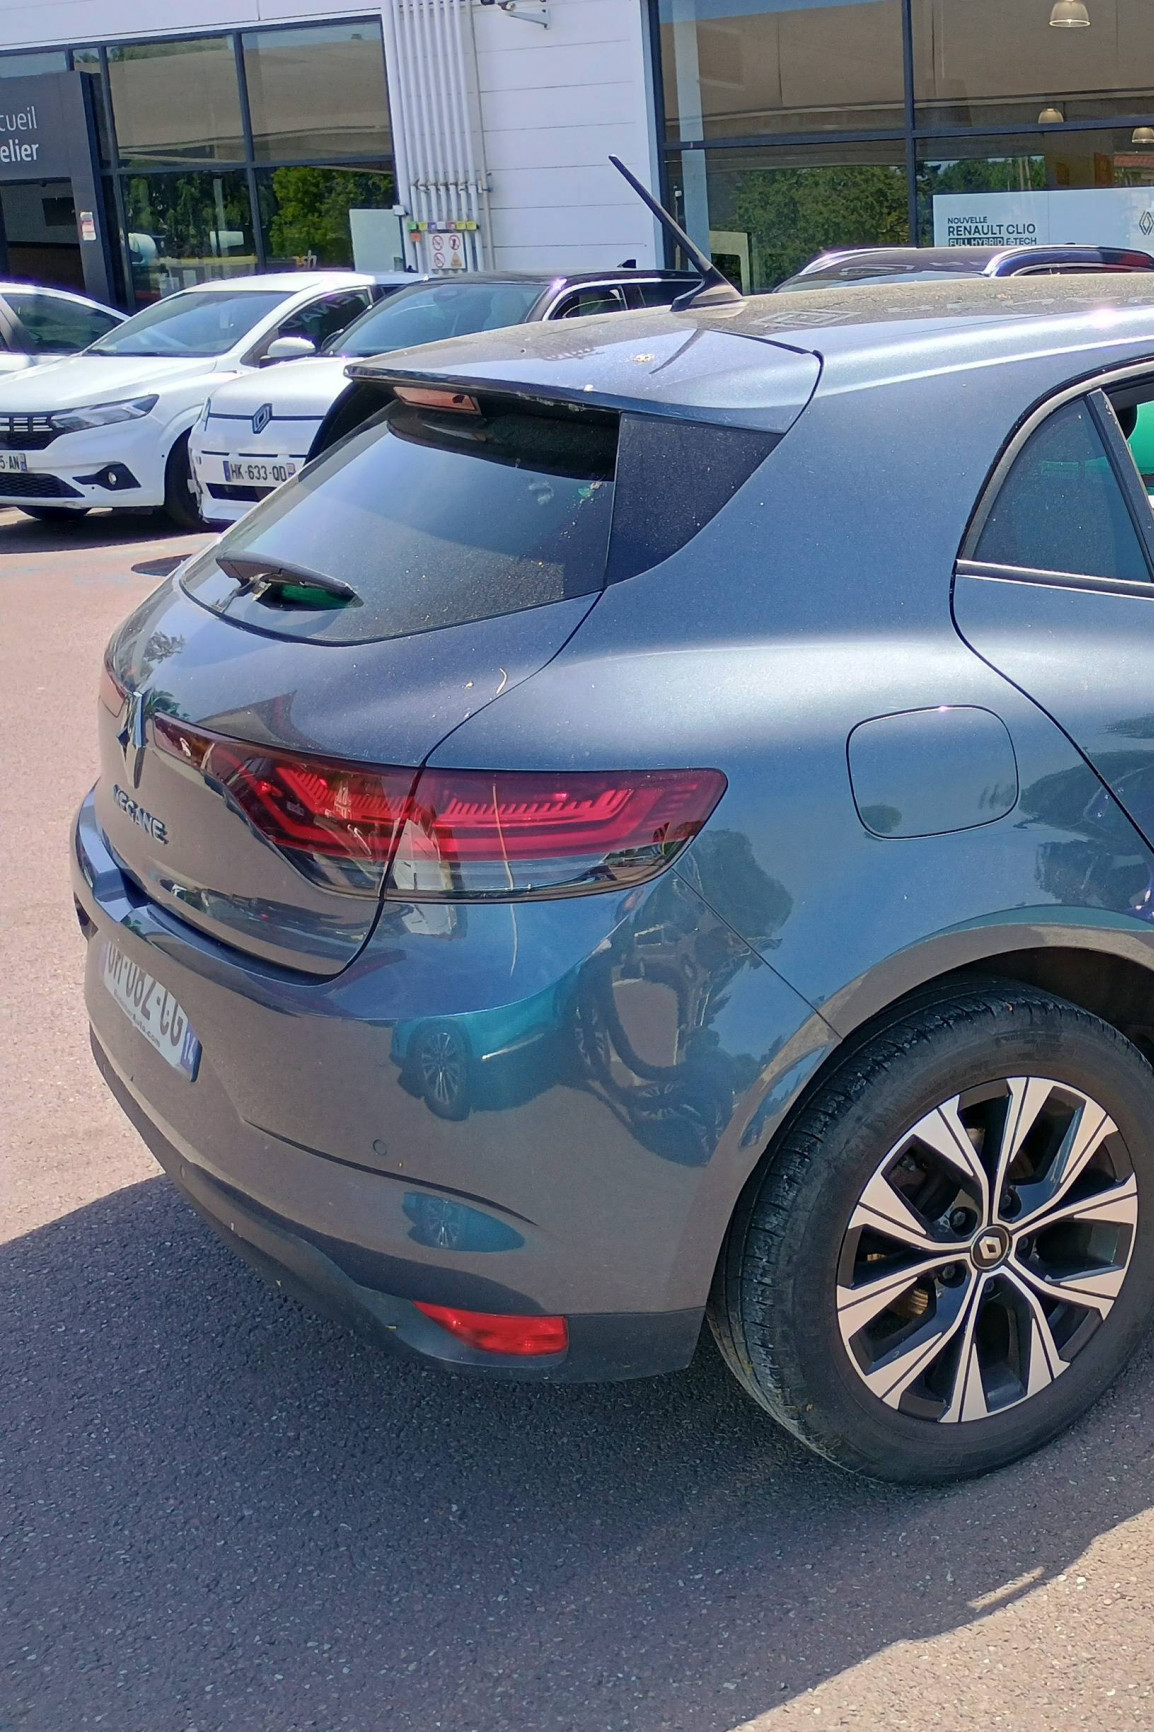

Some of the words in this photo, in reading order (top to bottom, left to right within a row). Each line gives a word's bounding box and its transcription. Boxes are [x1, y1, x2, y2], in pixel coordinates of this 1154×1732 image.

[947, 216, 988, 225] NOUVELLE
[948, 224, 1004, 236] RENAULT
[1006, 223, 1036, 235] CLIO
[949, 238, 970, 247] FULL
[971, 237, 1004, 246] HYBRID
[1006, 237, 1037, 246] E-TECH
